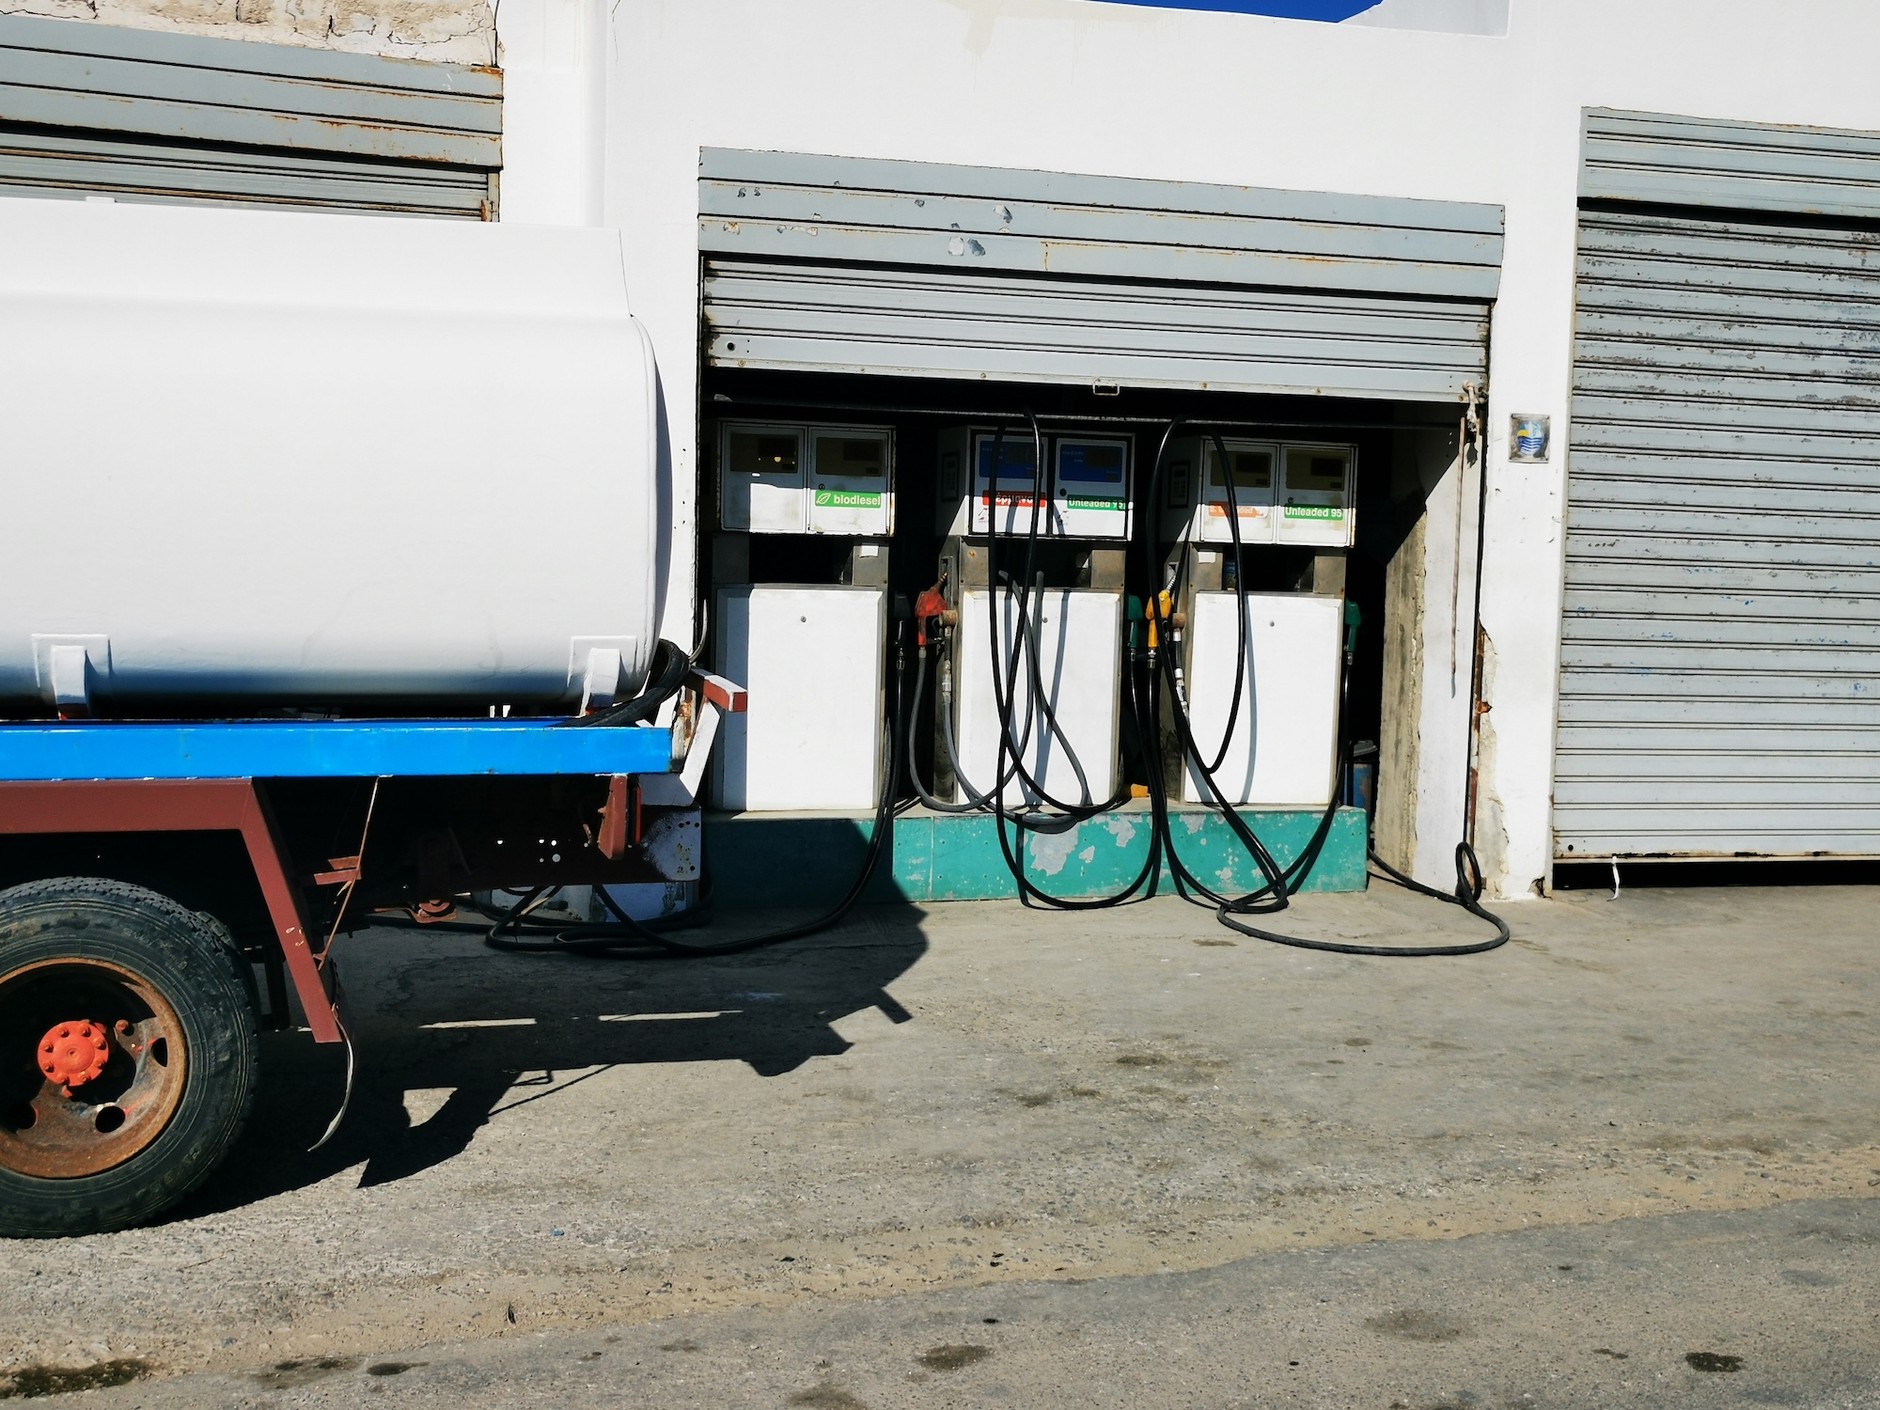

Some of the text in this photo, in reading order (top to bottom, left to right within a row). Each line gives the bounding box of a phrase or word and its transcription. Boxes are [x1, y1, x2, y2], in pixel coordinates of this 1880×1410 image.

[834, 494, 881, 506] biodiesel
[1069, 496, 1111, 508] Unleaded
[1285, 506, 1343, 518] Unleaded 95
